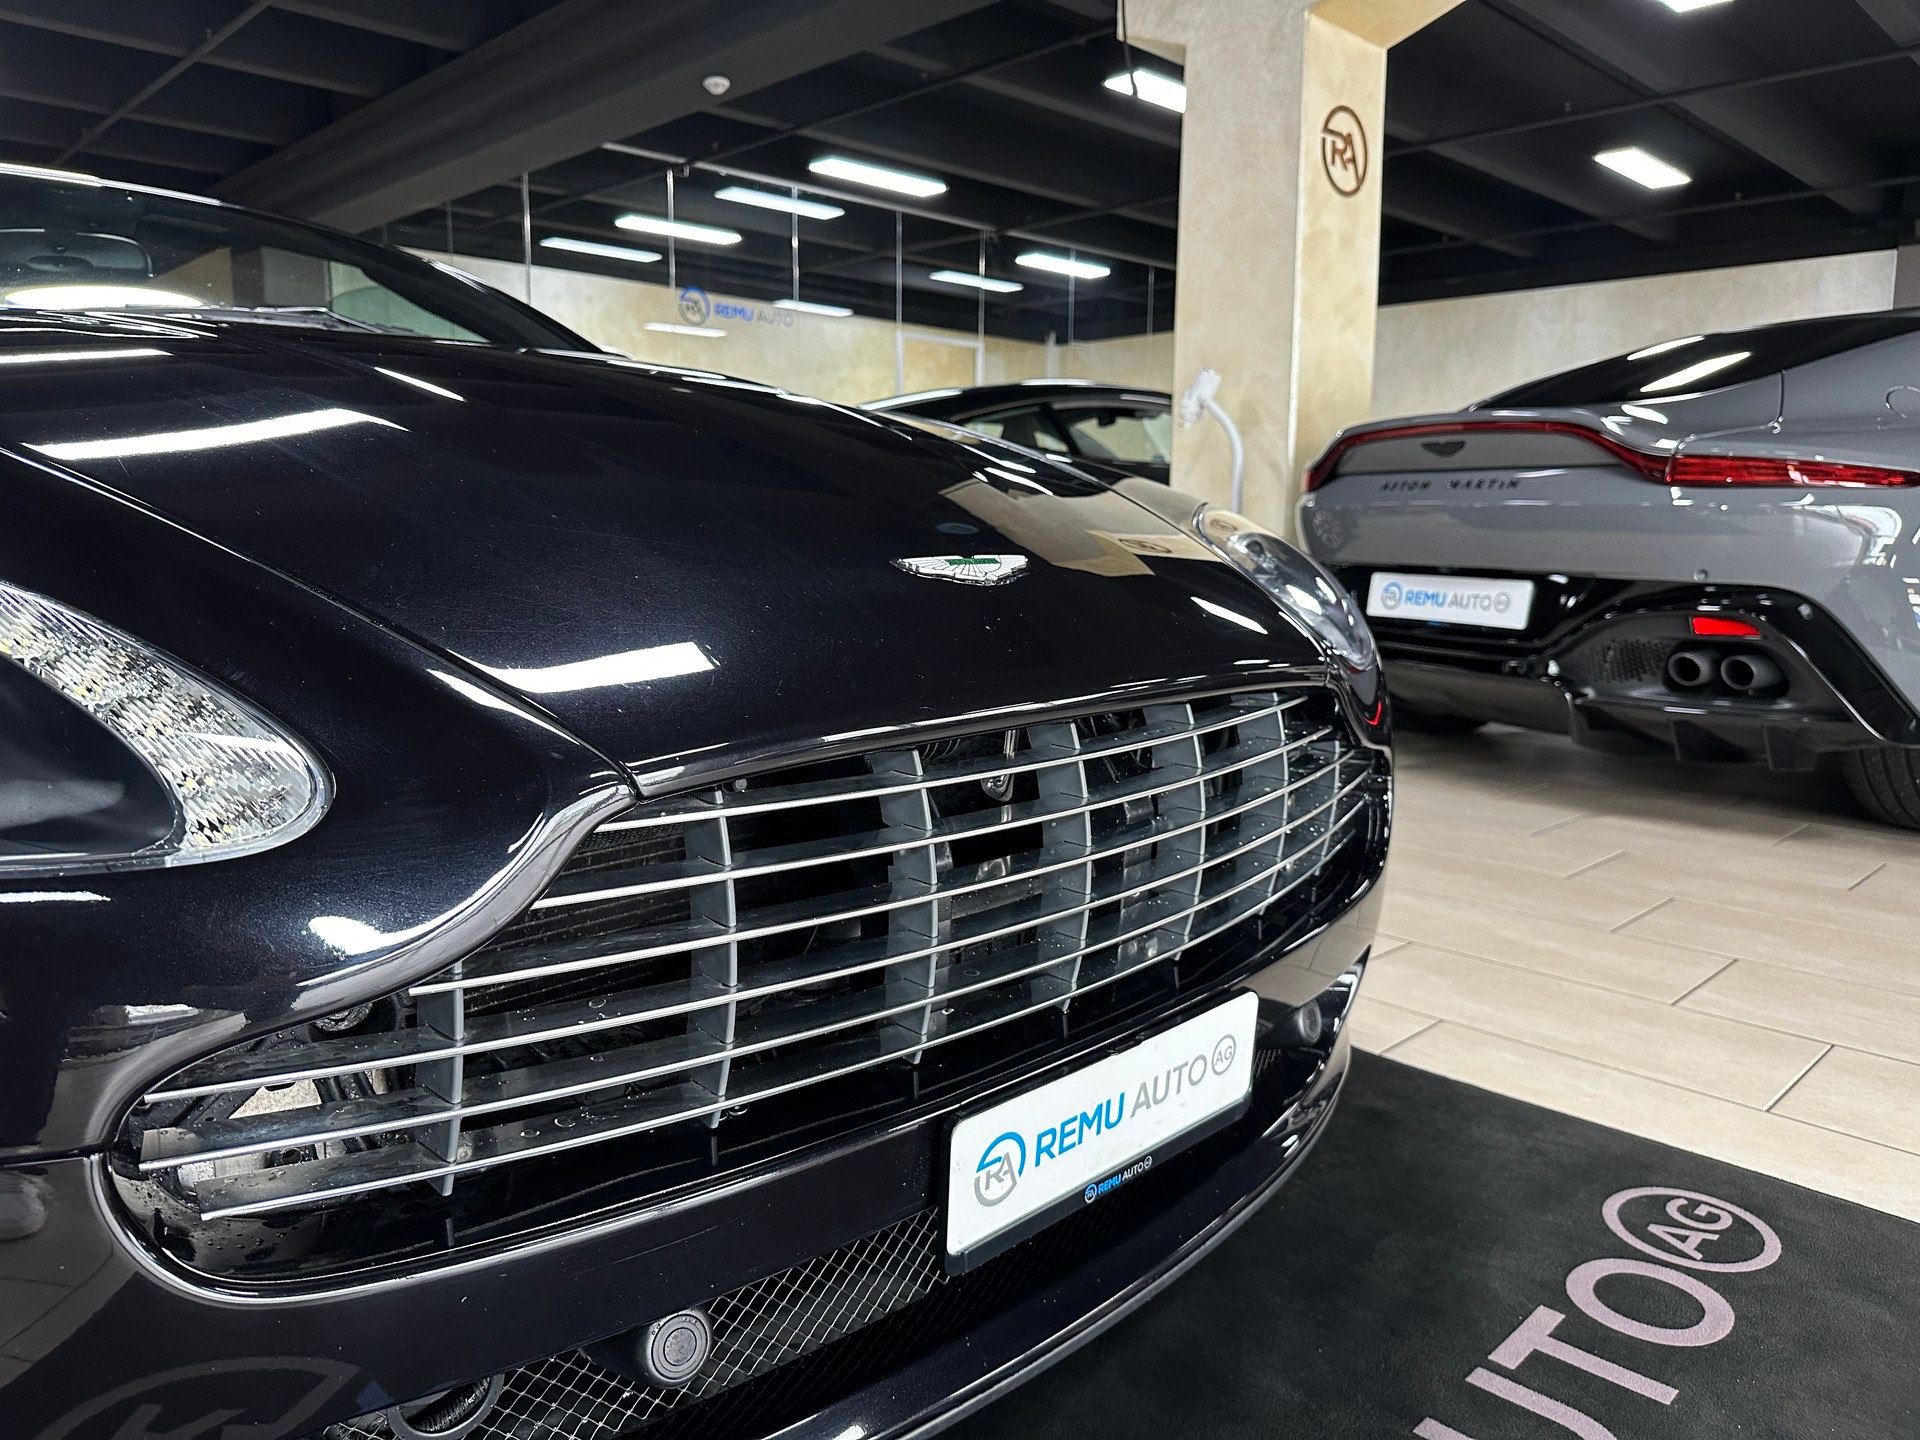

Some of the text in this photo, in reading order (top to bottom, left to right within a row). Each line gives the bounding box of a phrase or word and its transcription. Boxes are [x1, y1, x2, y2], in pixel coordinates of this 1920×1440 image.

[713, 302, 755, 322] REMU
[757, 311, 794, 327] AUTO
[1404, 589, 1448, 608] REMU
[1448, 592, 1492, 611] AUTO
[1034, 1092, 1125, 1168] REMU
[1130, 1054, 1207, 1118] AUTO
[1098, 1173, 1121, 1194] REMU
[1122, 1162, 1144, 1180] AUTO
[1647, 1197, 1733, 1261] AG
